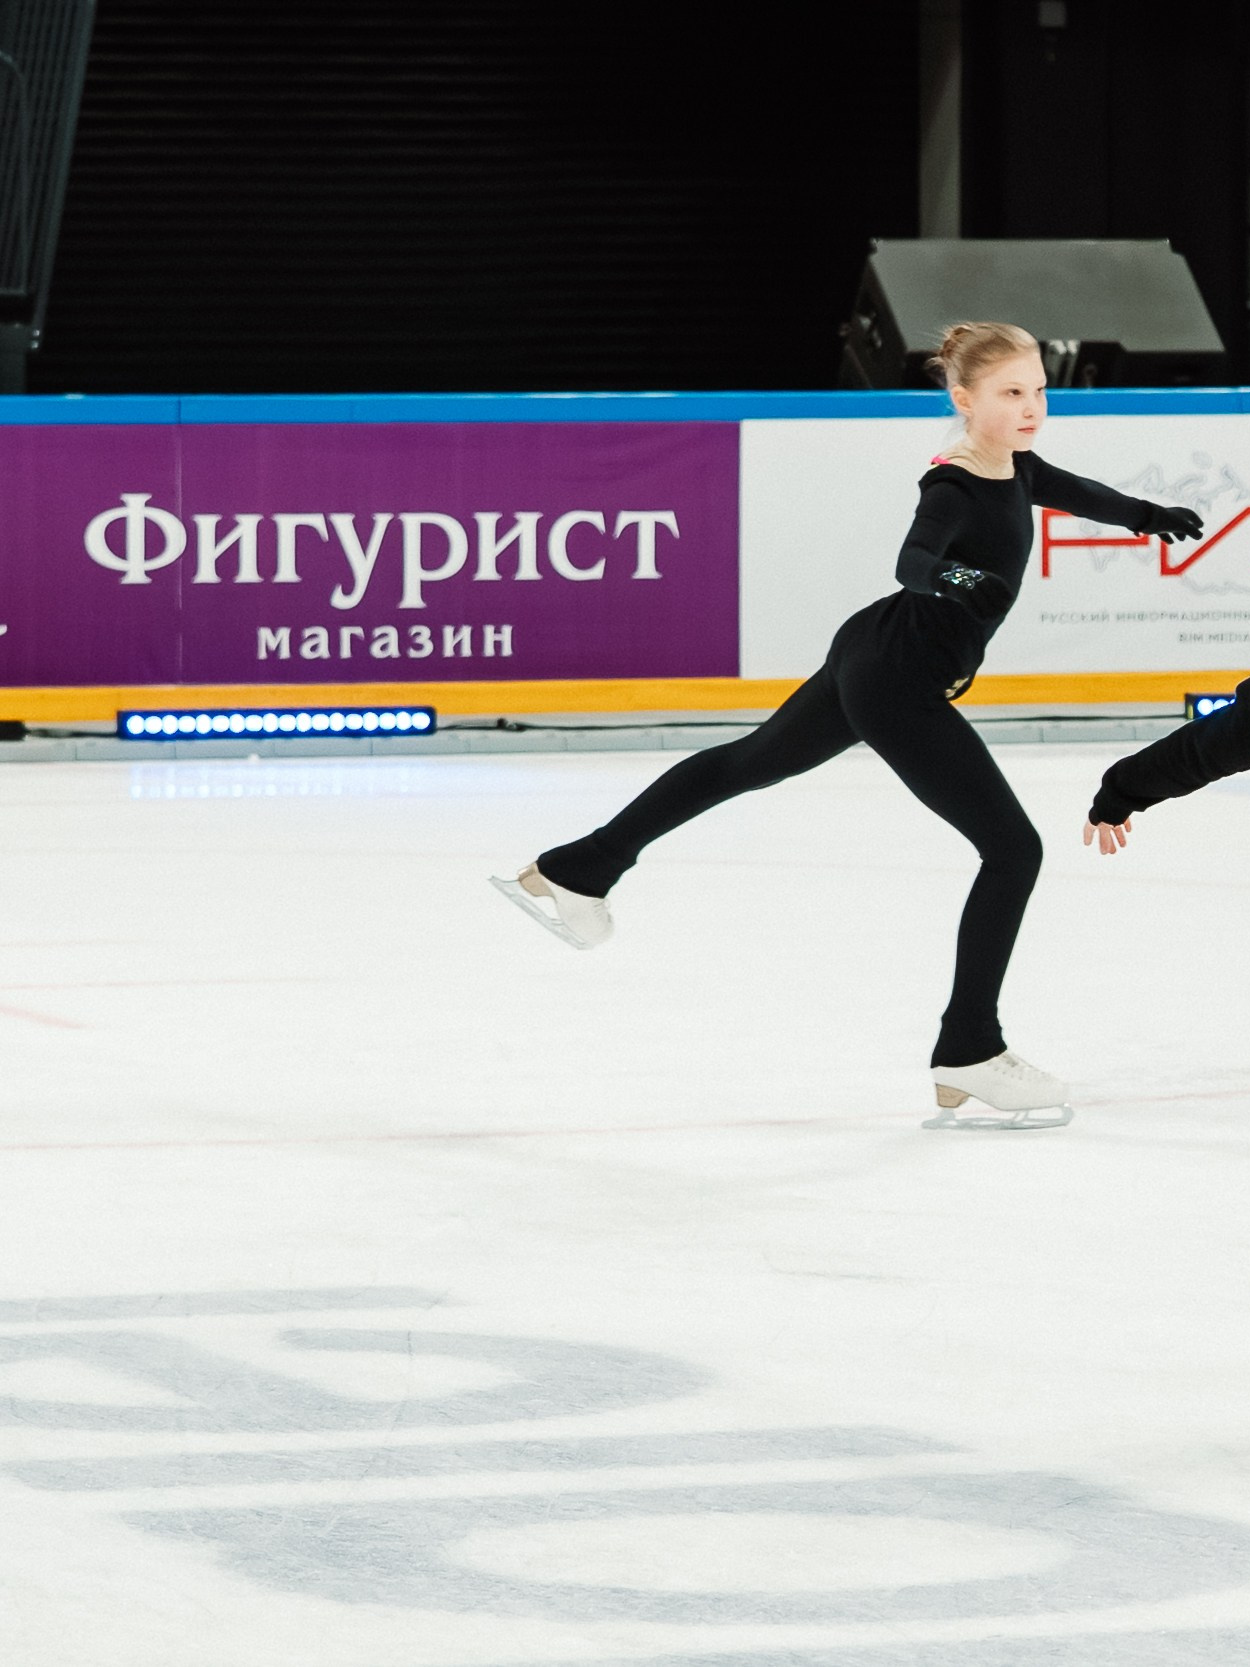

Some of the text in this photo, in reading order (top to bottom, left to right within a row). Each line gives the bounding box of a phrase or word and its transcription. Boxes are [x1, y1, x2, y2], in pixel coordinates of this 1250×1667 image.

[84, 493, 681, 611] Фигурист
[1040, 609, 1110, 623] РУССКИЙ
[257, 624, 515, 661] магазин
